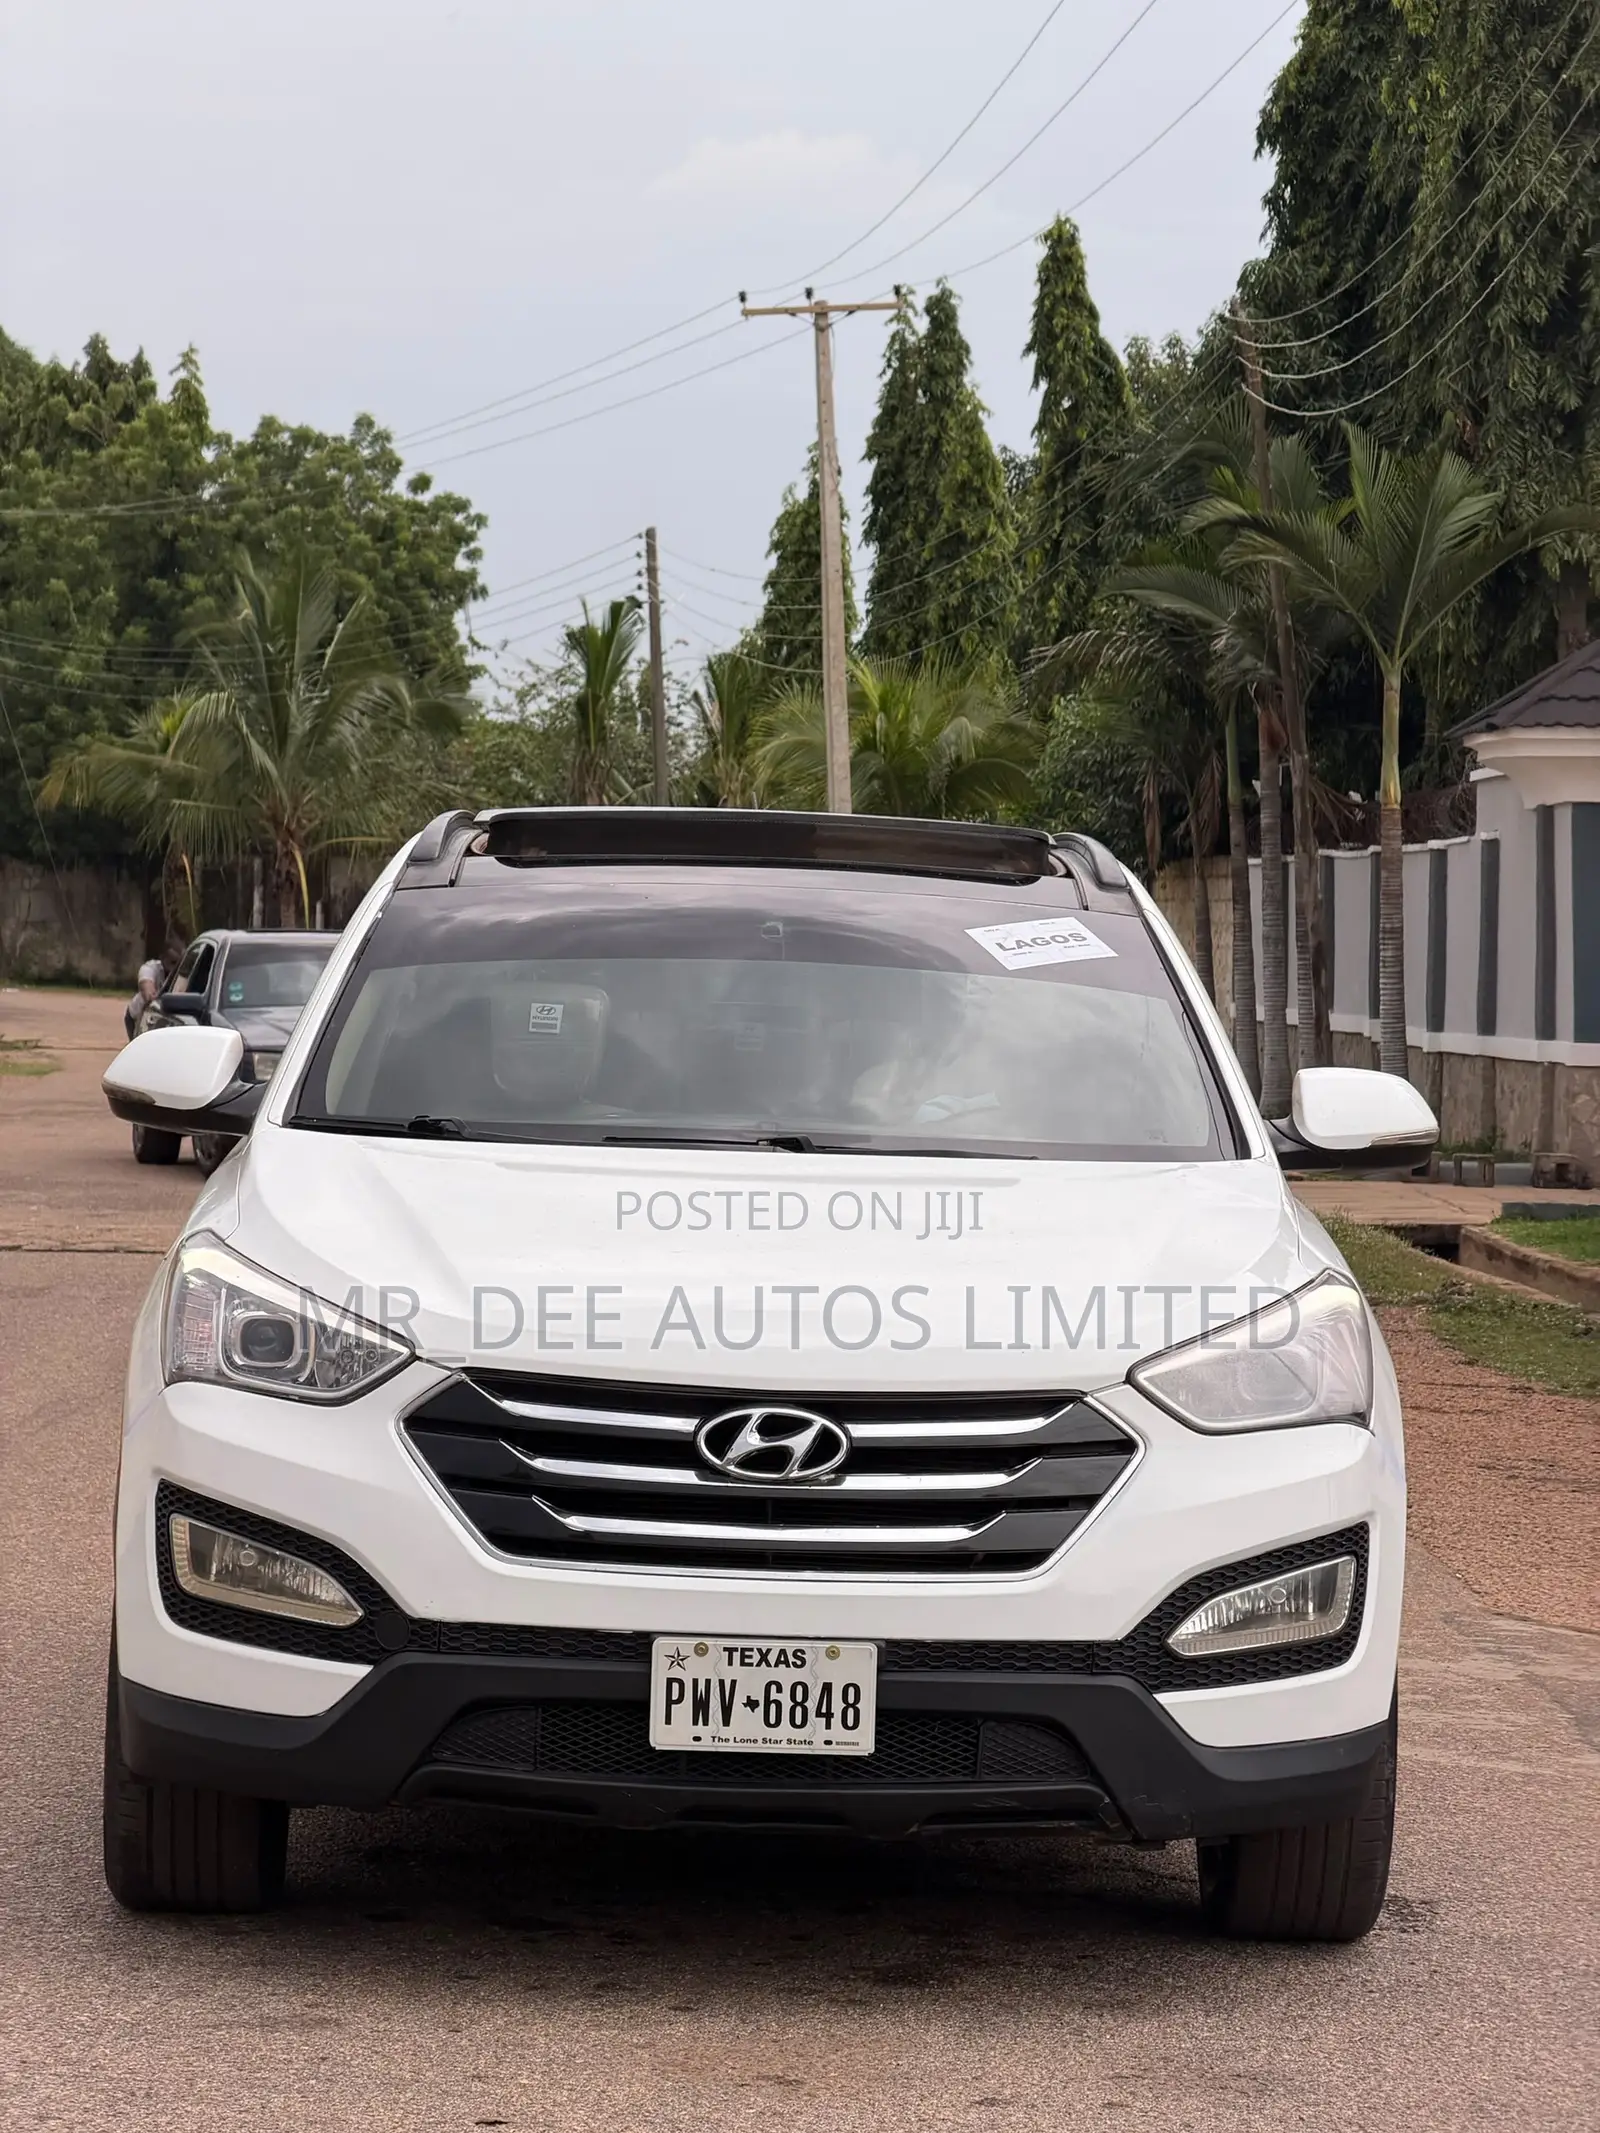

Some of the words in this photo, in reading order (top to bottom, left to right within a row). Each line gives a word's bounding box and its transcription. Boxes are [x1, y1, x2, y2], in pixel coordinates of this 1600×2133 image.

[995, 932, 1088, 952] LAGOS
[723, 1647, 807, 1669] TEXAS
[664, 1677, 738, 1728] PWV
[763, 1680, 861, 1731] 6848
[711, 1735, 730, 1744] The
[733, 1736, 759, 1745] Lone
[761, 1736, 784, 1746] Star
[786, 1737, 814, 1747] State
